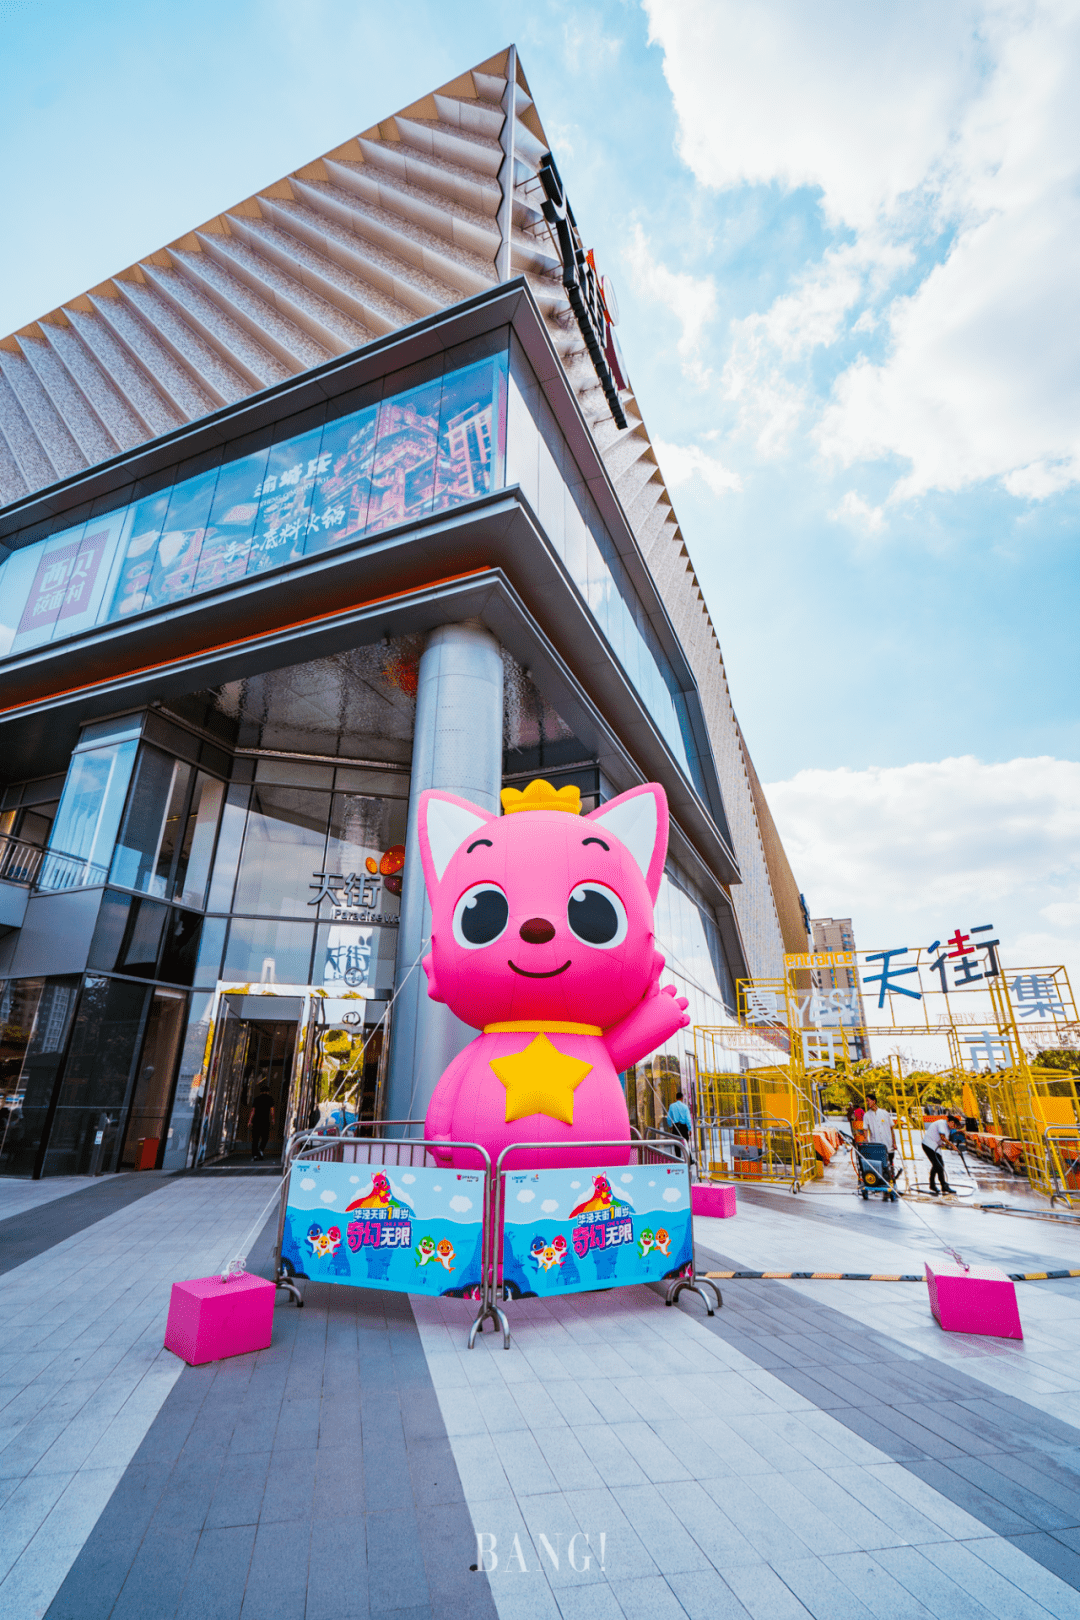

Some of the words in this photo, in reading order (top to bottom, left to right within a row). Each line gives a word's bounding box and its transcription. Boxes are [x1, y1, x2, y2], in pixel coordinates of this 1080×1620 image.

[223, 505, 346, 563] 手工底料火锅
[40, 550, 95, 593] 西贝
[307, 872, 381, 909] 天街
[335, 909, 382, 921] Paradise
[785, 952, 853, 967] entrance
[863, 924, 1000, 1008] 天街
[789, 988, 858, 1027] YES!
[347, 1221, 411, 1251] 奇幻无限
[573, 1223, 633, 1257] 奇幻无限
